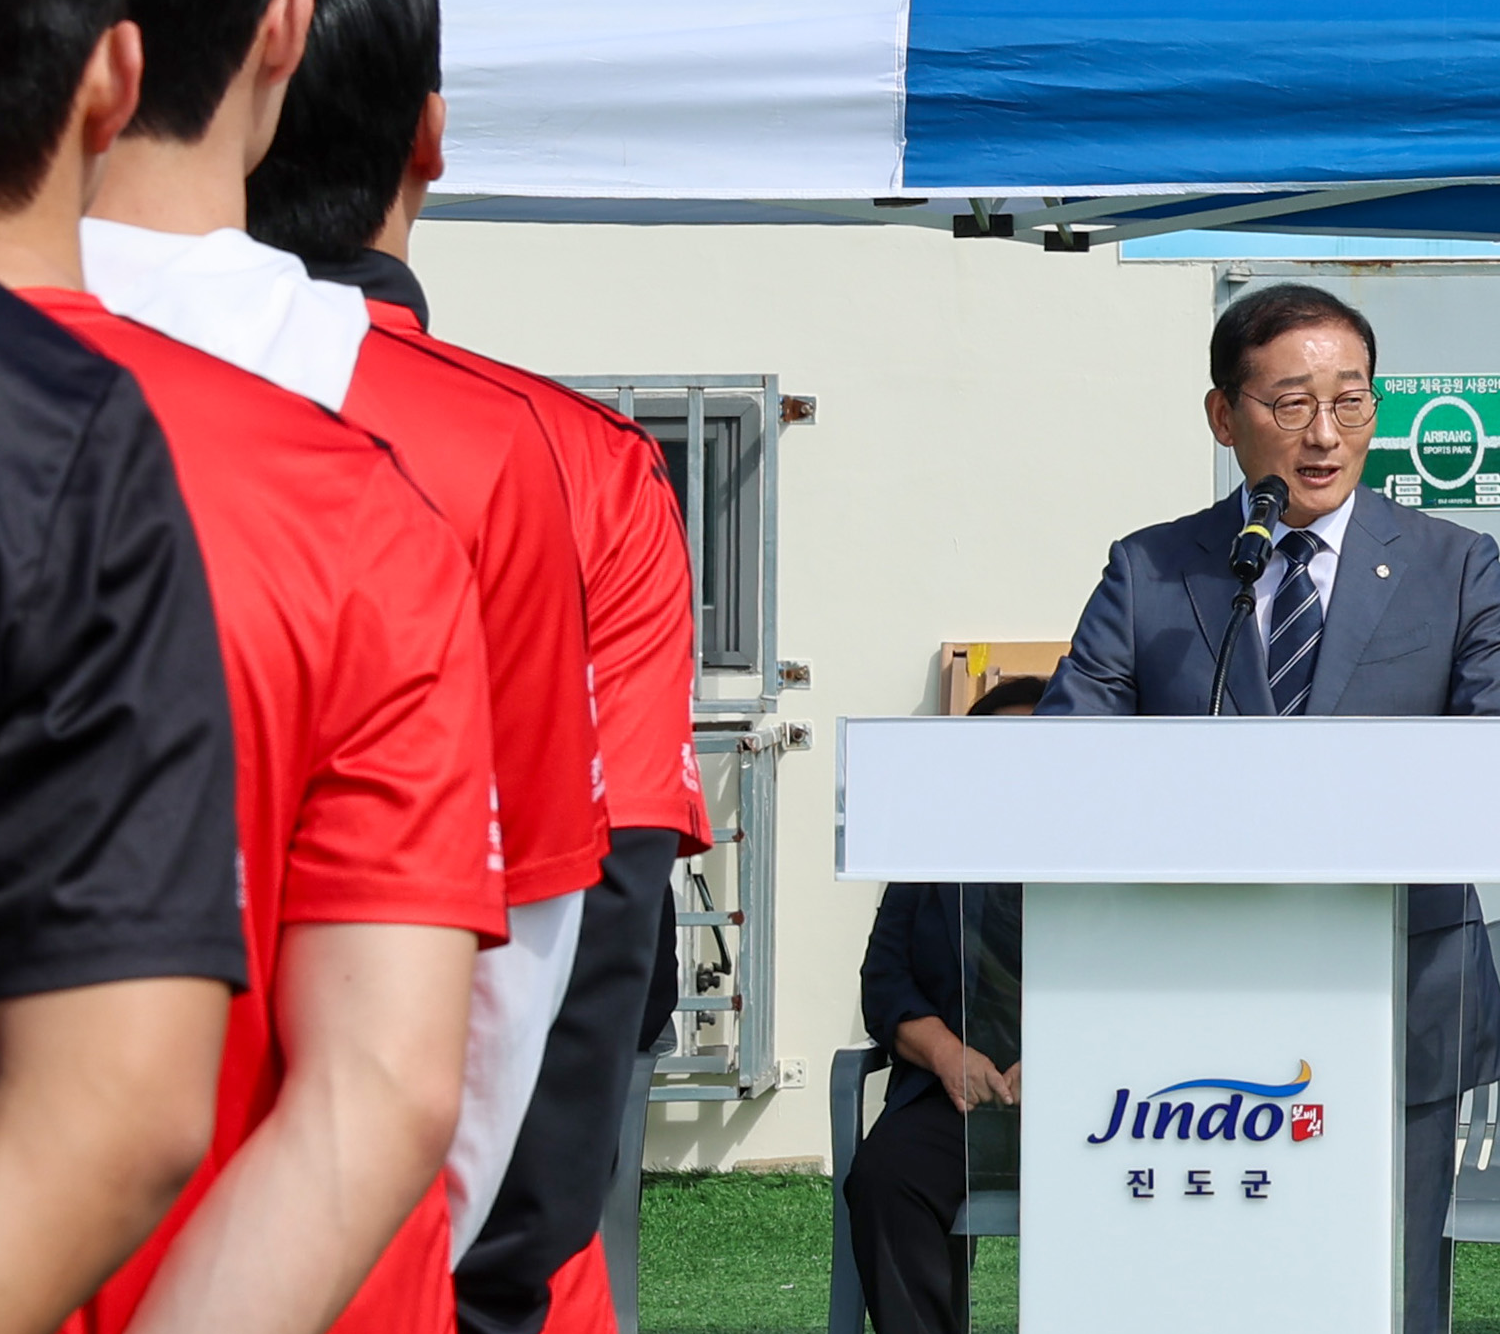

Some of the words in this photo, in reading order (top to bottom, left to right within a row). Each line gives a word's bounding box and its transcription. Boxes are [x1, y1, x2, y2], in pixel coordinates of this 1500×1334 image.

[1384, 378, 1418, 395] 아리랑
[1420, 378, 1464, 395] 체육공원
[1423, 430, 1472, 444] ARIRANG
[1423, 445, 1451, 455] SPORTS
[1452, 445, 1473, 454] PARK
[1086, 1088, 1285, 1145] Jindo
